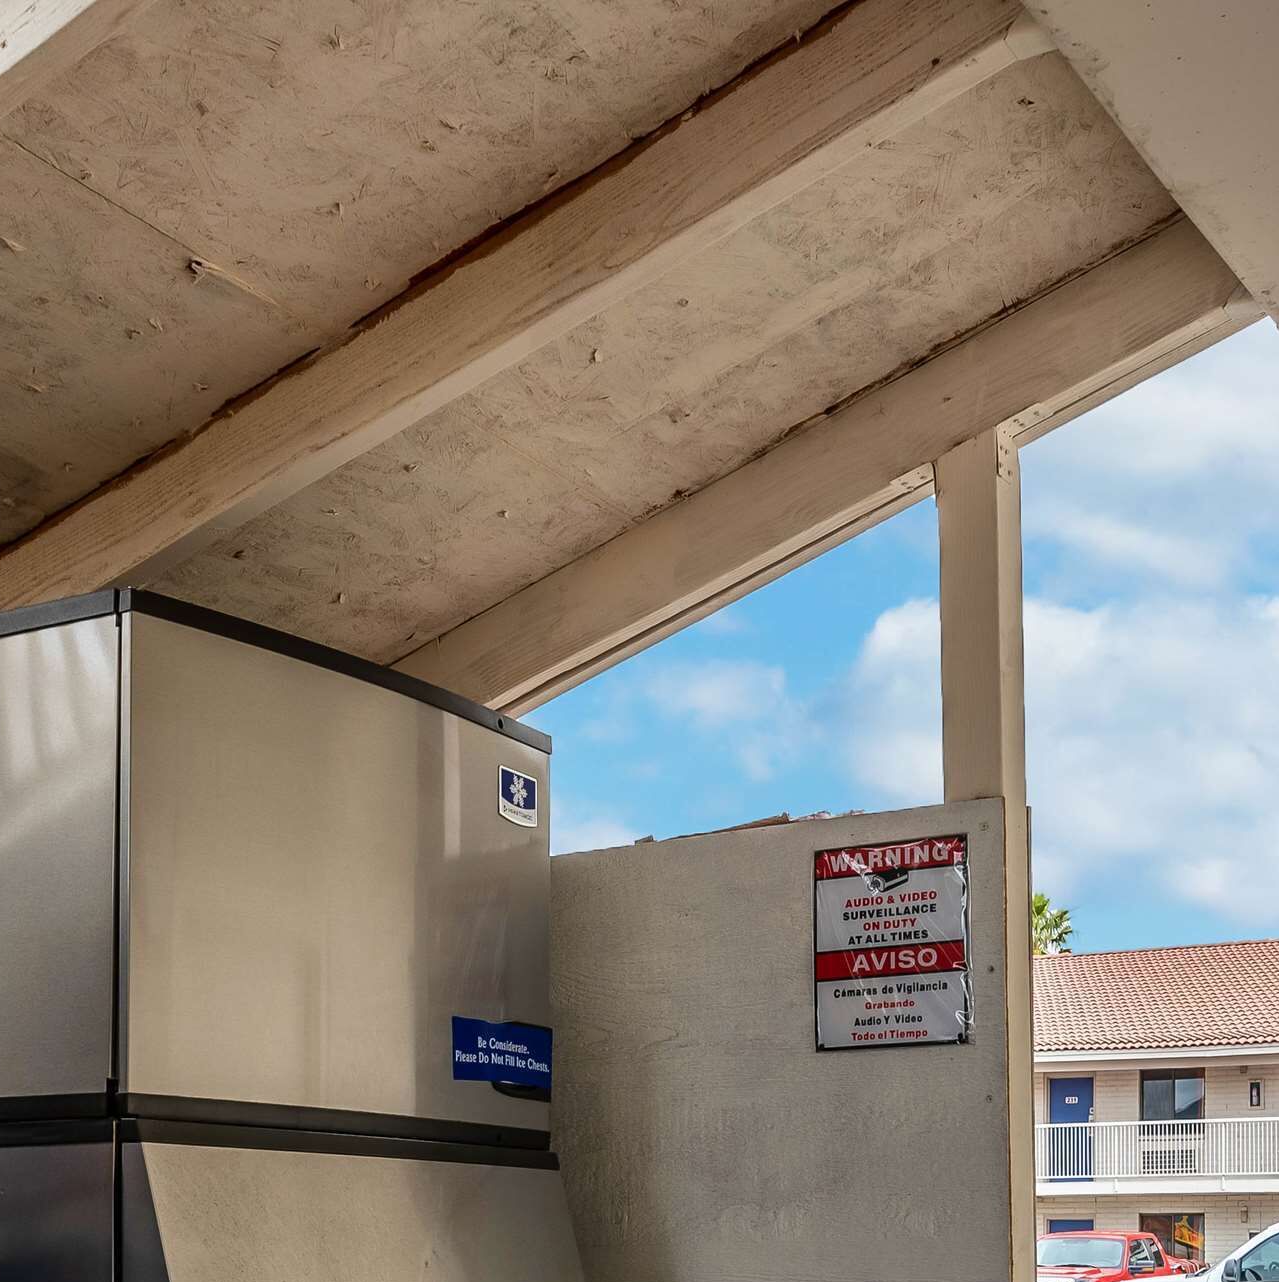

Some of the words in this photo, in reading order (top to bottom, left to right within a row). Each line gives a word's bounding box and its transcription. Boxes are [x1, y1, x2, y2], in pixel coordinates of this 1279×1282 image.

[830, 844, 949, 873] WARNING
[845, 896, 883, 908] AUDIO
[887, 896, 895, 904] &
[899, 891, 937, 902] VIDEO
[843, 904, 937, 921] SURVEILLANCE
[863, 920, 880, 931] ON
[884, 918, 917, 929] DUTY
[848, 935, 862, 945] AT
[865, 933, 888, 944] ALL
[890, 929, 929, 941] TIMES
[853, 948, 938, 973] AVISO
[882, 984, 894, 995] de
[896, 980, 948, 995] Vigilancia
[864, 1000, 915, 1010] Grabando
[854, 1016, 882, 1027] Audio
[884, 1016, 890, 1025] Y
[895, 1013, 923, 1025] Video
[851, 1031, 875, 1041] Todo
[878, 1030, 887, 1040] el
[889, 1029, 928, 1040] Tiempo
[477, 1036, 487, 1048] Be
[489, 1037, 530, 1054] Considerate.
[455, 1050, 477, 1063] Please
[478, 1052, 489, 1063] Do
[491, 1053, 504, 1065] Not
[505, 1054, 515, 1067] Fill
[516, 1057, 526, 1068] Ice
[527, 1058, 550, 1073] Chests.
